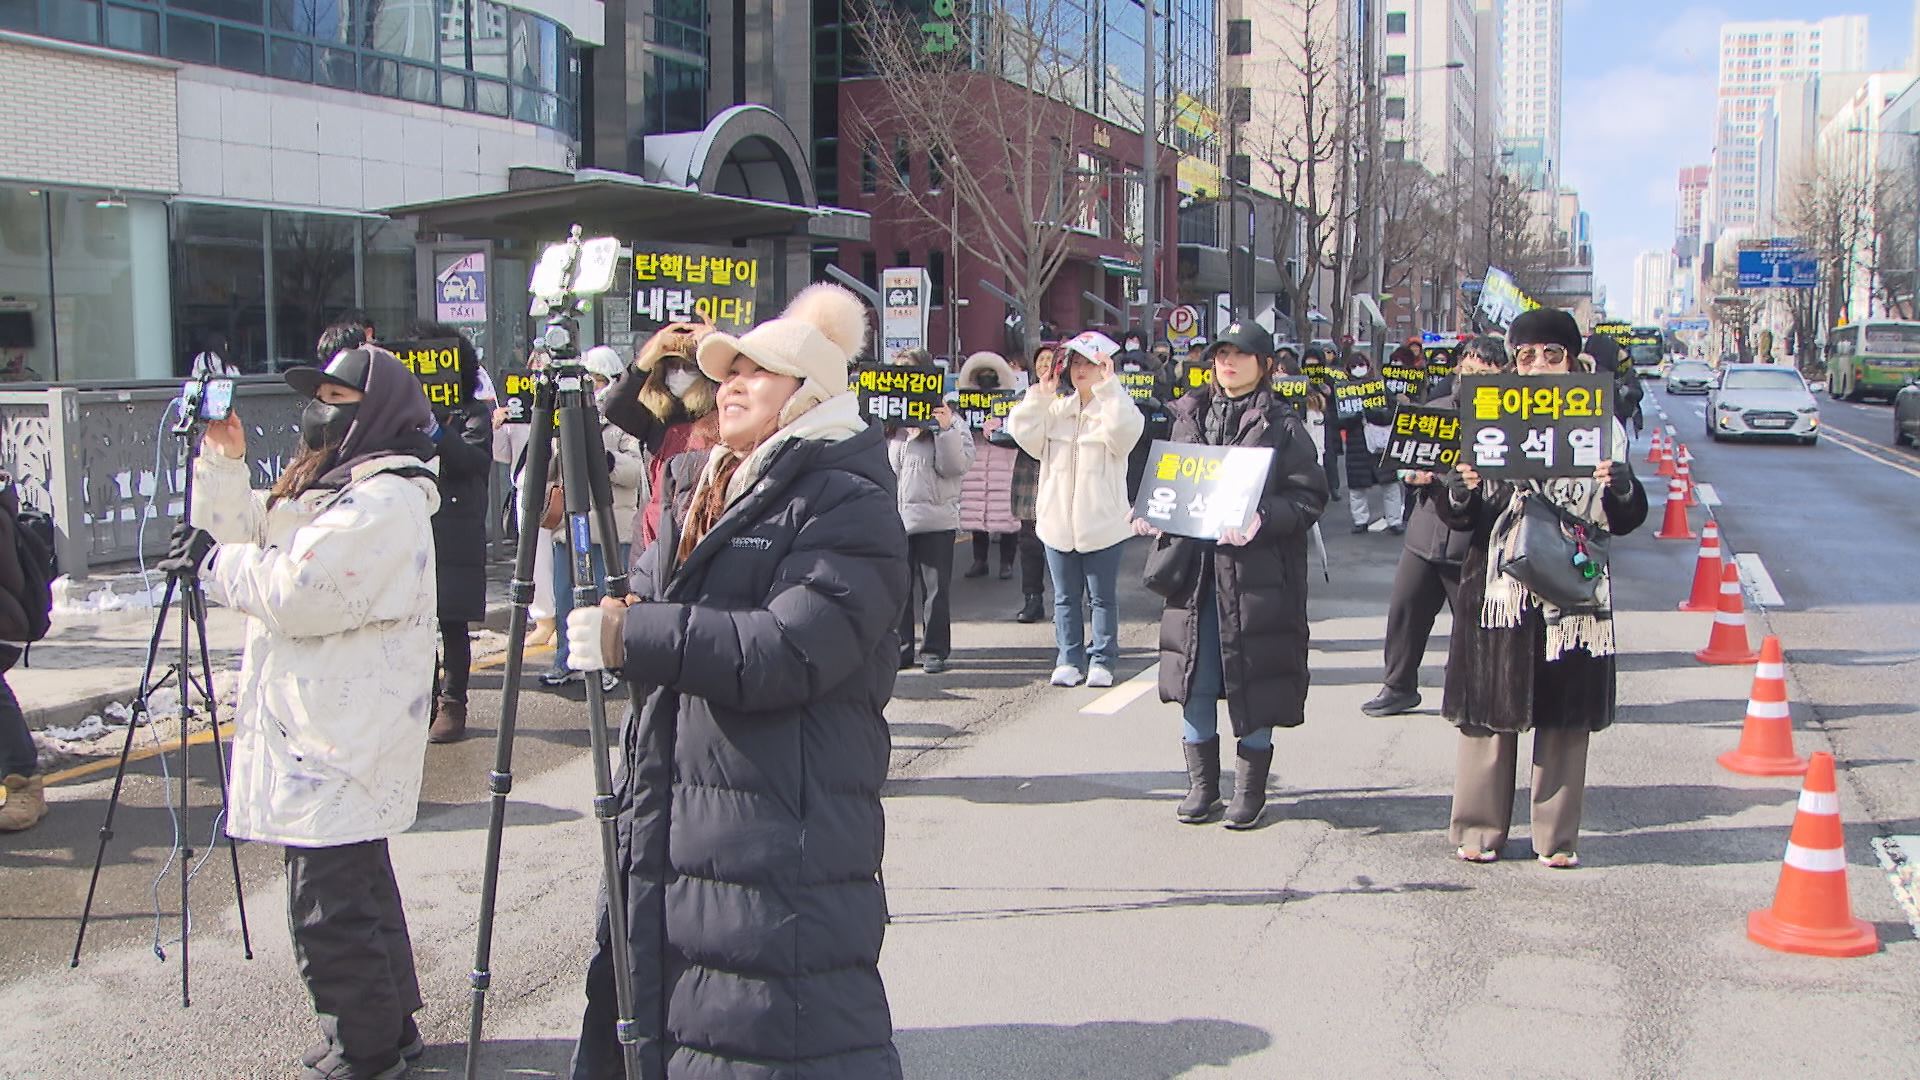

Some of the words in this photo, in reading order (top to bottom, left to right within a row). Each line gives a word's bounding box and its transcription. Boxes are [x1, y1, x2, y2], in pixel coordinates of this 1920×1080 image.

[636, 253, 757, 288] 탄핵남발이
[449, 306, 475, 318] TAXI
[636, 287, 753, 326] 내란이다!
[506, 375, 535, 395] 돌아
[860, 370, 943, 394] 예산삭감이
[868, 395, 932, 421] 테러다!
[960, 393, 1004, 409] 탄핵남
[1472, 386, 1603, 421] 돌아와요!
[1396, 412, 1462, 441] 탄핵남
[1389, 439, 1461, 467] 내란이
[1473, 427, 1509, 467] 윤
[1520, 426, 1554, 467] 석
[1567, 426, 1601, 466] 열
[1145, 487, 1178, 520] 윤
